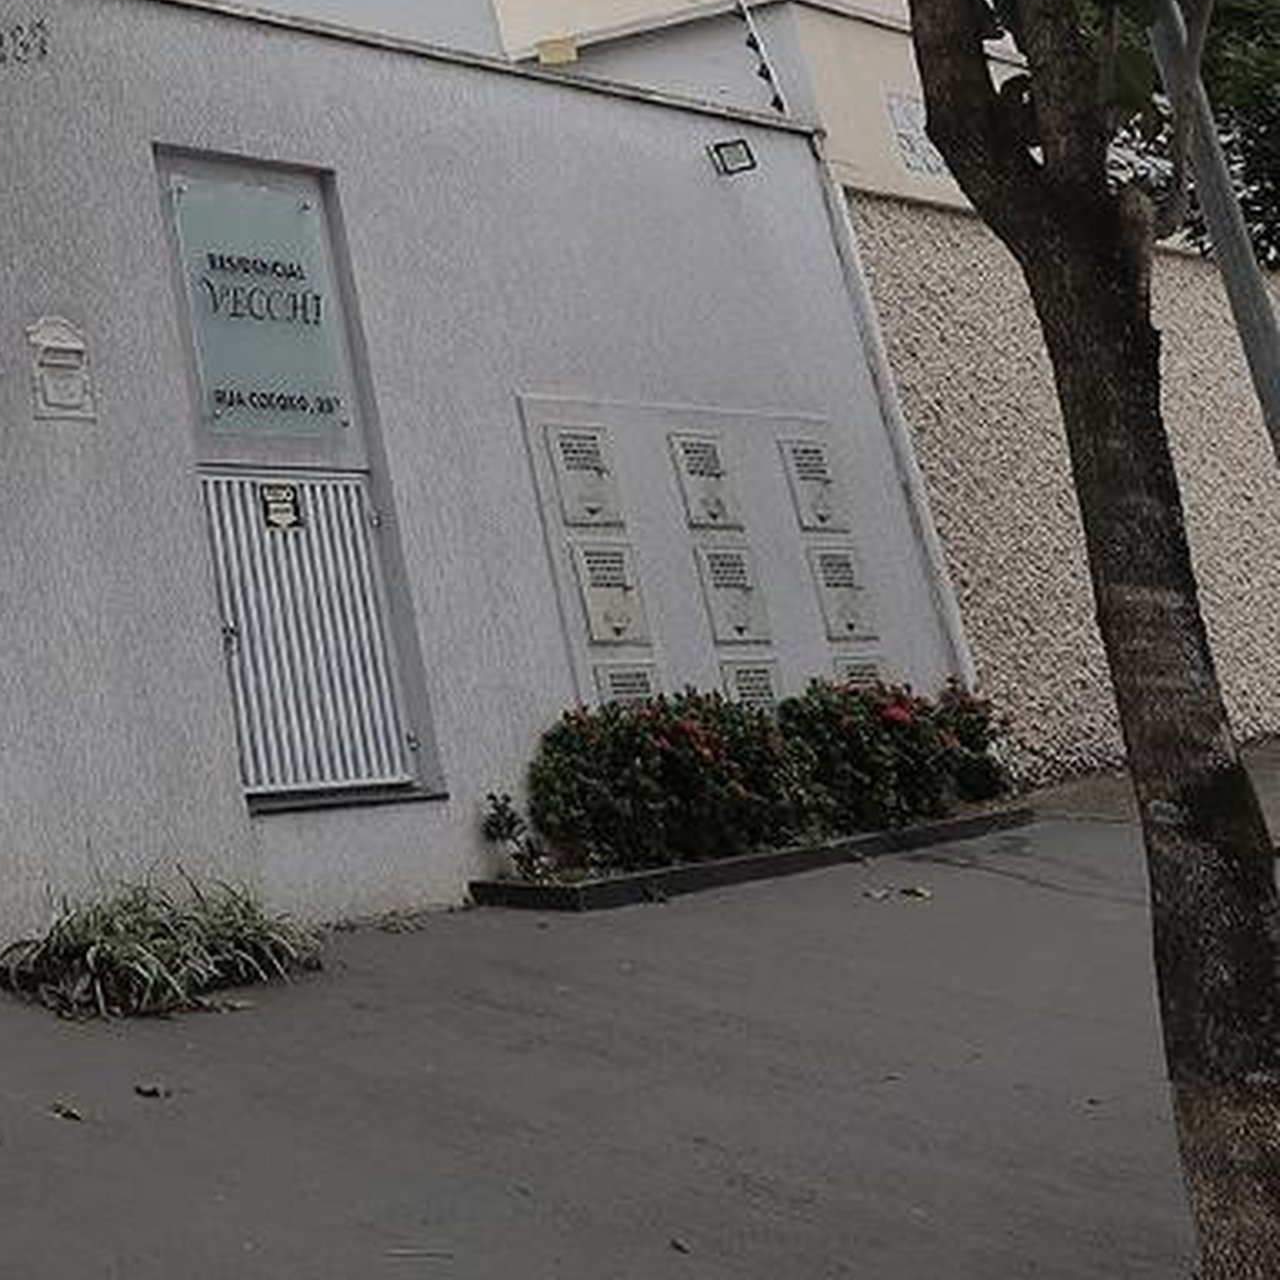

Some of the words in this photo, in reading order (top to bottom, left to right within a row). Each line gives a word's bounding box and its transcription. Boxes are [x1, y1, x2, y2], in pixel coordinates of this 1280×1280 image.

[205, 252, 307, 281] RESIDENCIAL
[201, 276, 324, 326] VECCHI
[214, 389, 247, 408] RUA
